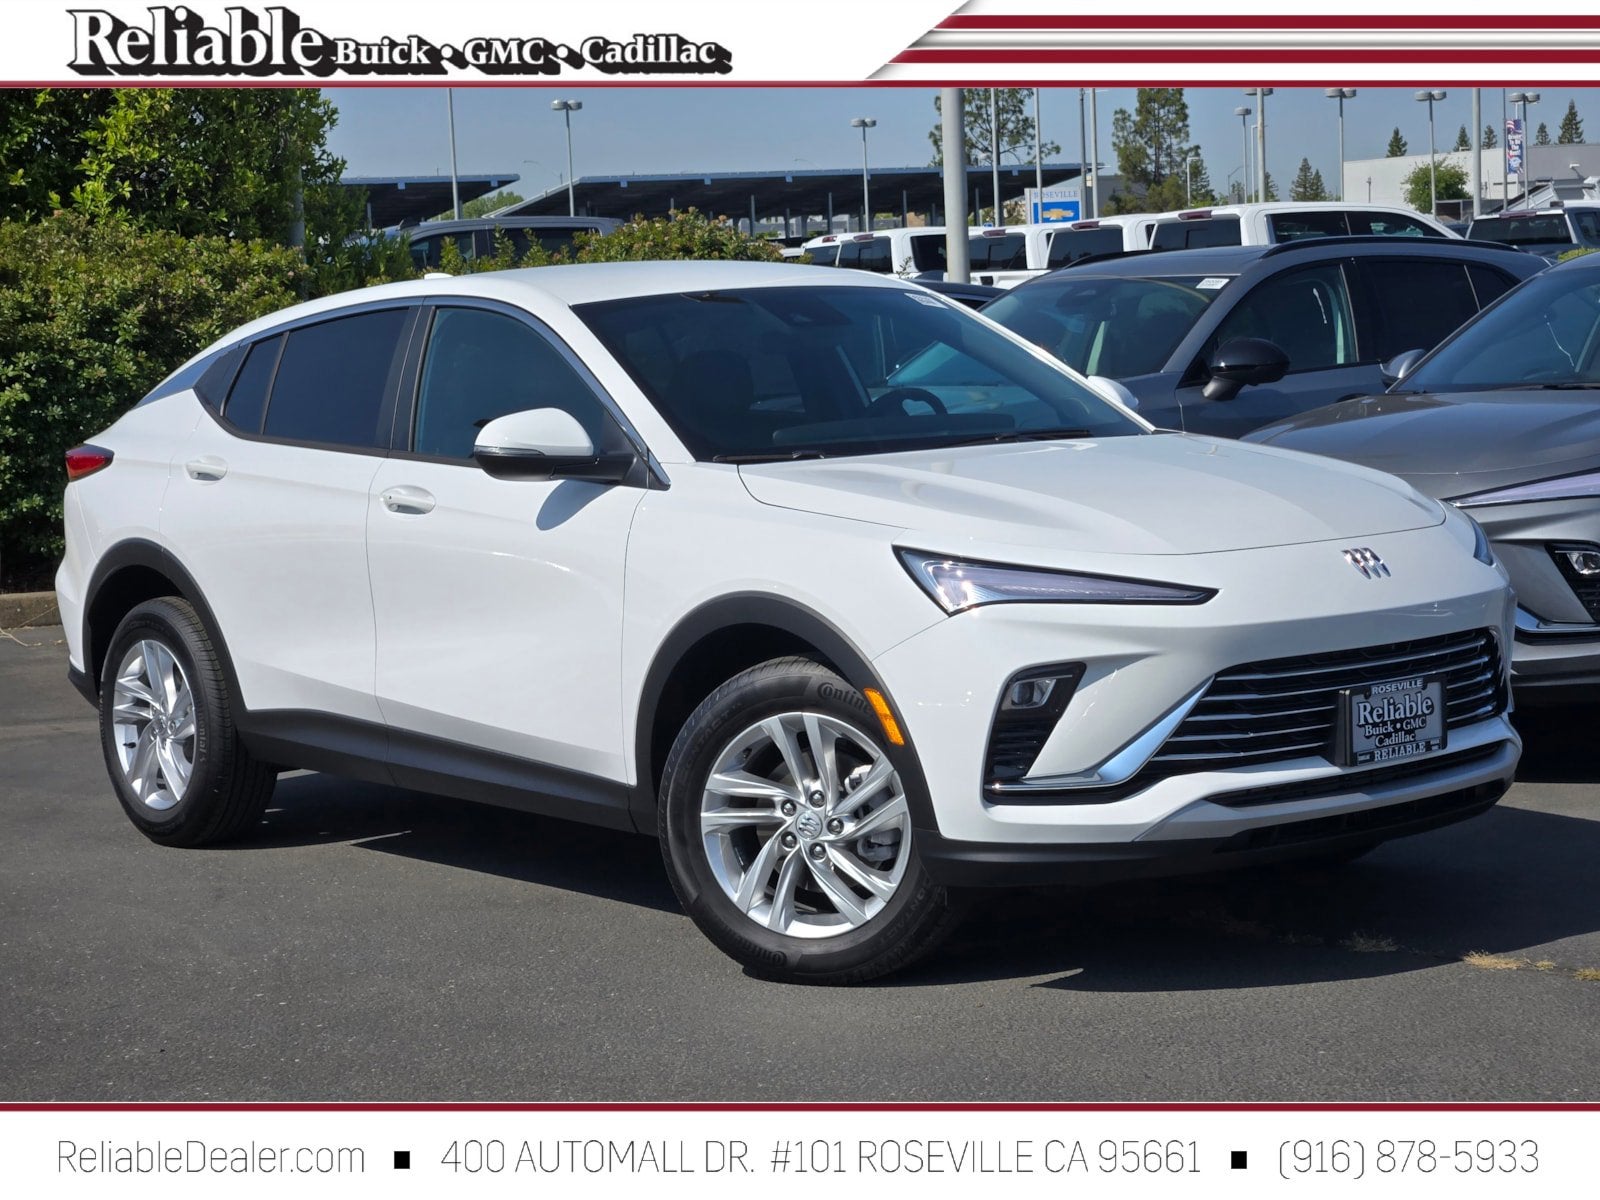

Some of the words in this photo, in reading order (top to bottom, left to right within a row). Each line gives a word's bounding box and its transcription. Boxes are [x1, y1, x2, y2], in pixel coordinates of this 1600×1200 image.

[1372, 679, 1424, 695] ROSEVILLE
[1357, 692, 1433, 726] Reliable
[1364, 721, 1394, 737] Buick
[1402, 716, 1426, 731] GMC
[1375, 731, 1415, 748] Cadillac
[1374, 742, 1426, 762] RELIABLE
